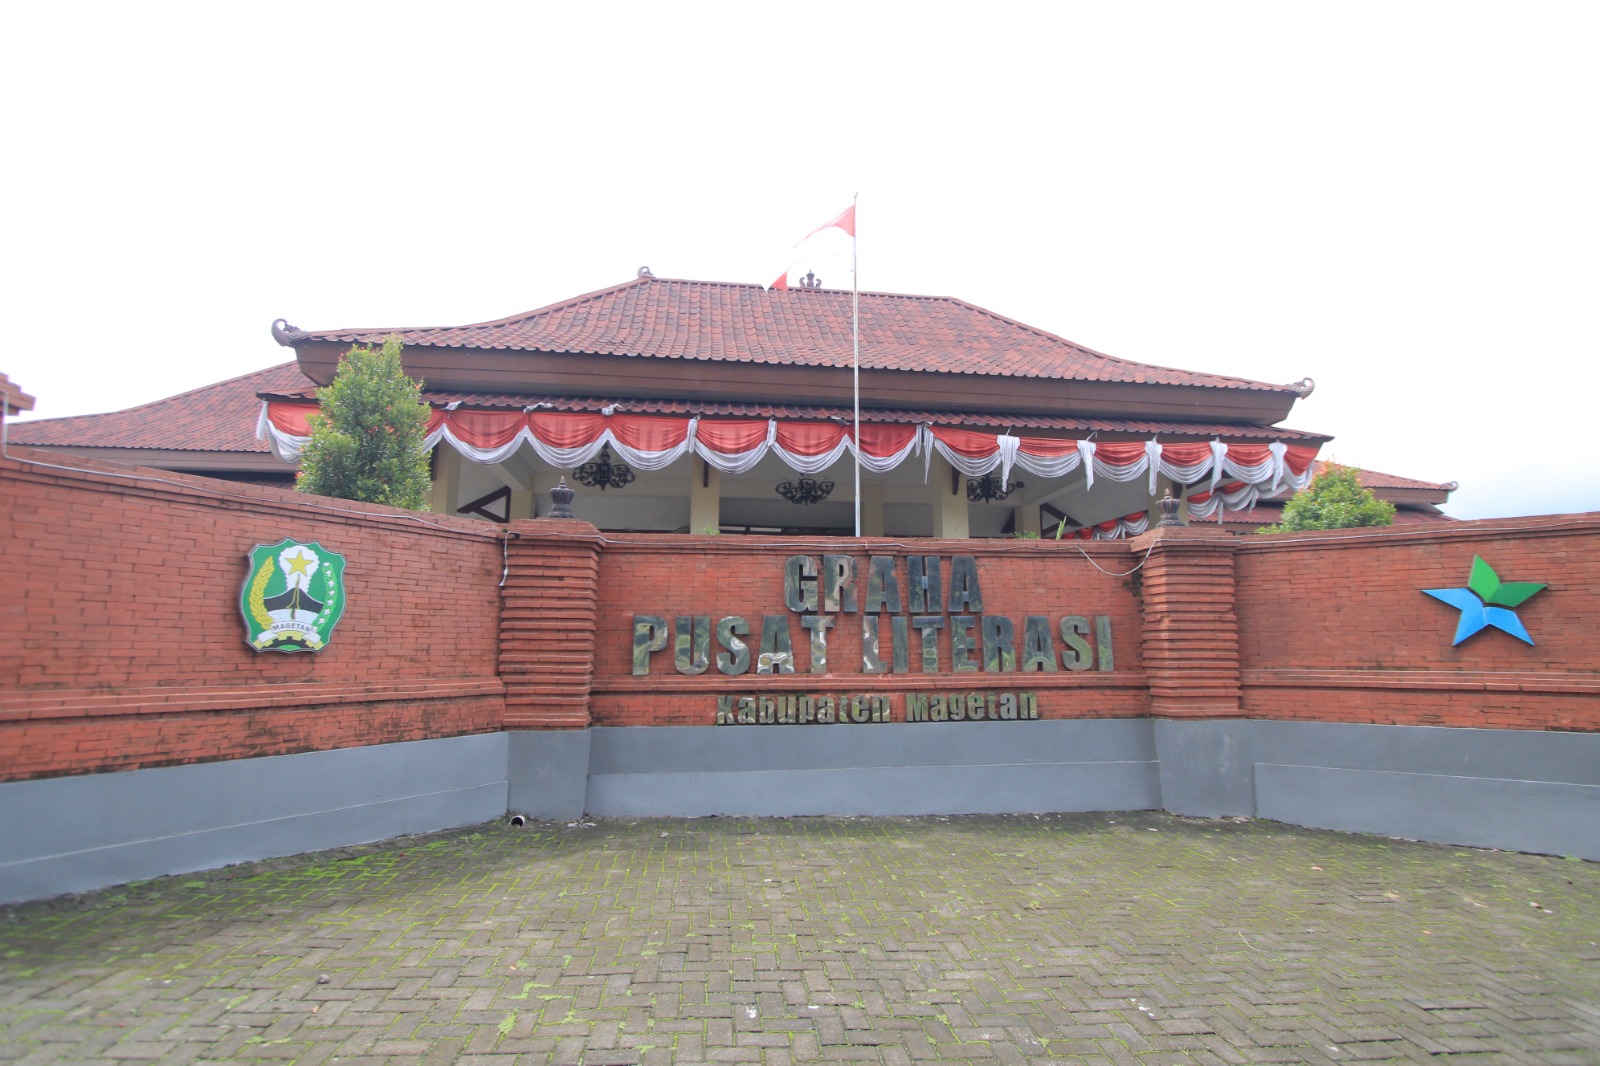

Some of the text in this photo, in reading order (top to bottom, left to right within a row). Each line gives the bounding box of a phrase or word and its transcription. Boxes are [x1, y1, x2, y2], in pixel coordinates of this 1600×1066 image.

[784, 555, 983, 613] GRAHA
[272, 623, 310, 632] MAGETAN
[632, 615, 1115, 676] PUSAT LITERASI
[717, 691, 1038, 726] Kabupaten Magetan
